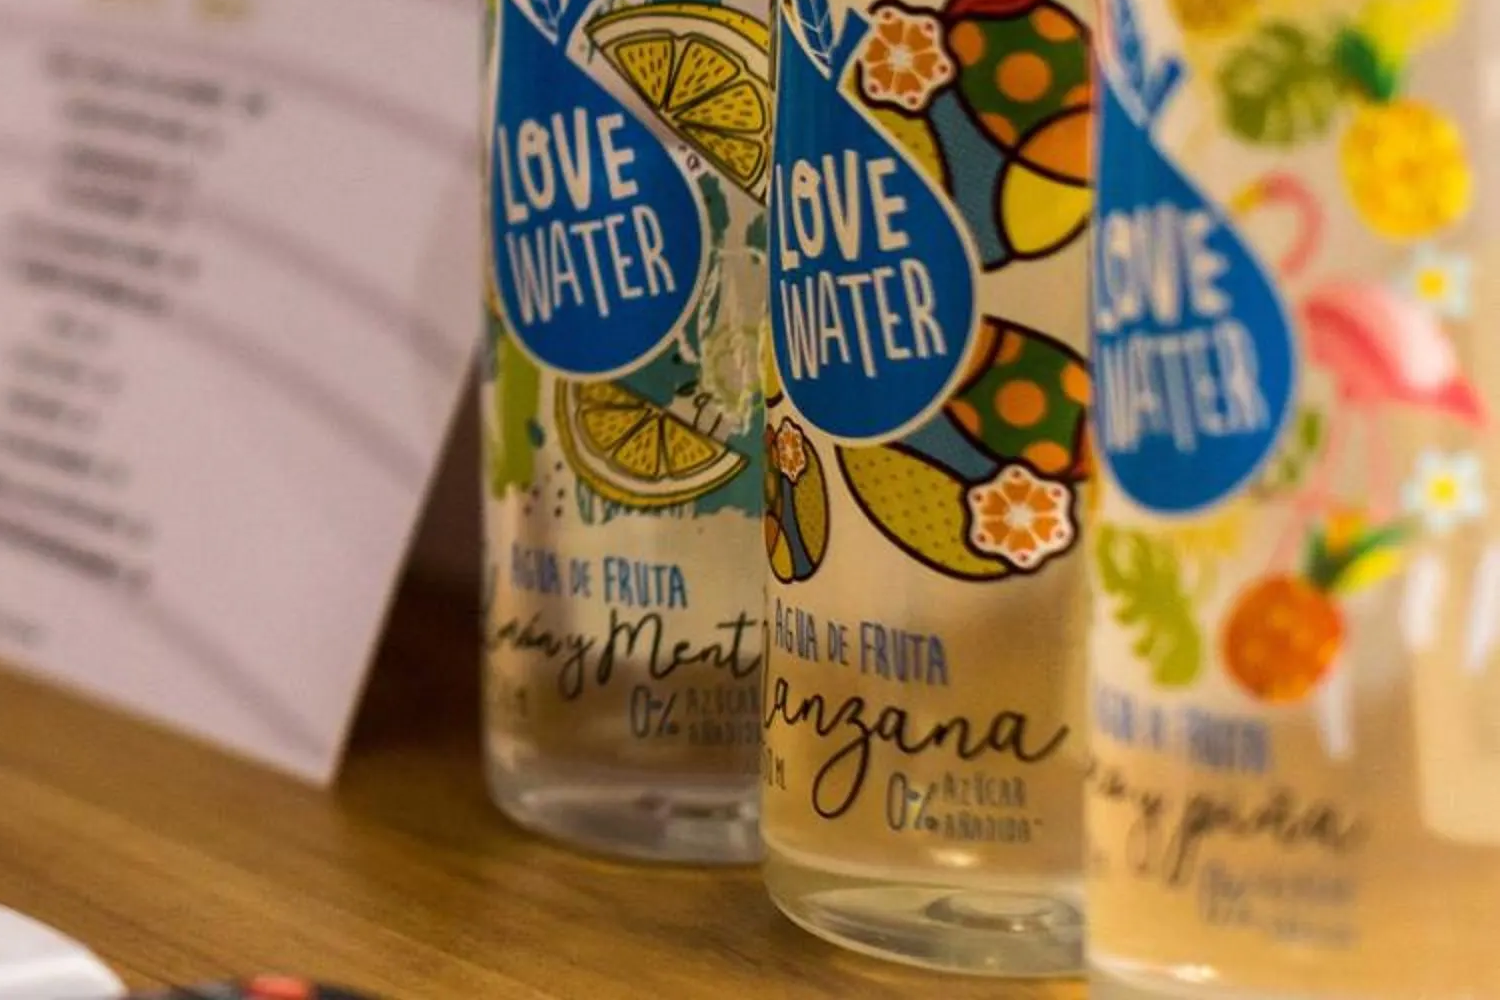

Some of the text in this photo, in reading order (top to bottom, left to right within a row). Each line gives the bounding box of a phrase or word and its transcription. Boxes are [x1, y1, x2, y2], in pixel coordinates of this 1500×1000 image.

[498, 106, 640, 225] LOVE
[775, 148, 910, 272] LOVE
[505, 204, 677, 326] WATER
[780, 257, 947, 381] WATER
[1102, 320, 1272, 453] WATER
[568, 557, 592, 598] DE
[602, 555, 688, 609] FRUTA
[597, 608, 762, 686] Ment
[775, 597, 948, 686] AGUA DE FRUTA
[630, 684, 680, 739] 0%
[886, 771, 939, 832] 0%
